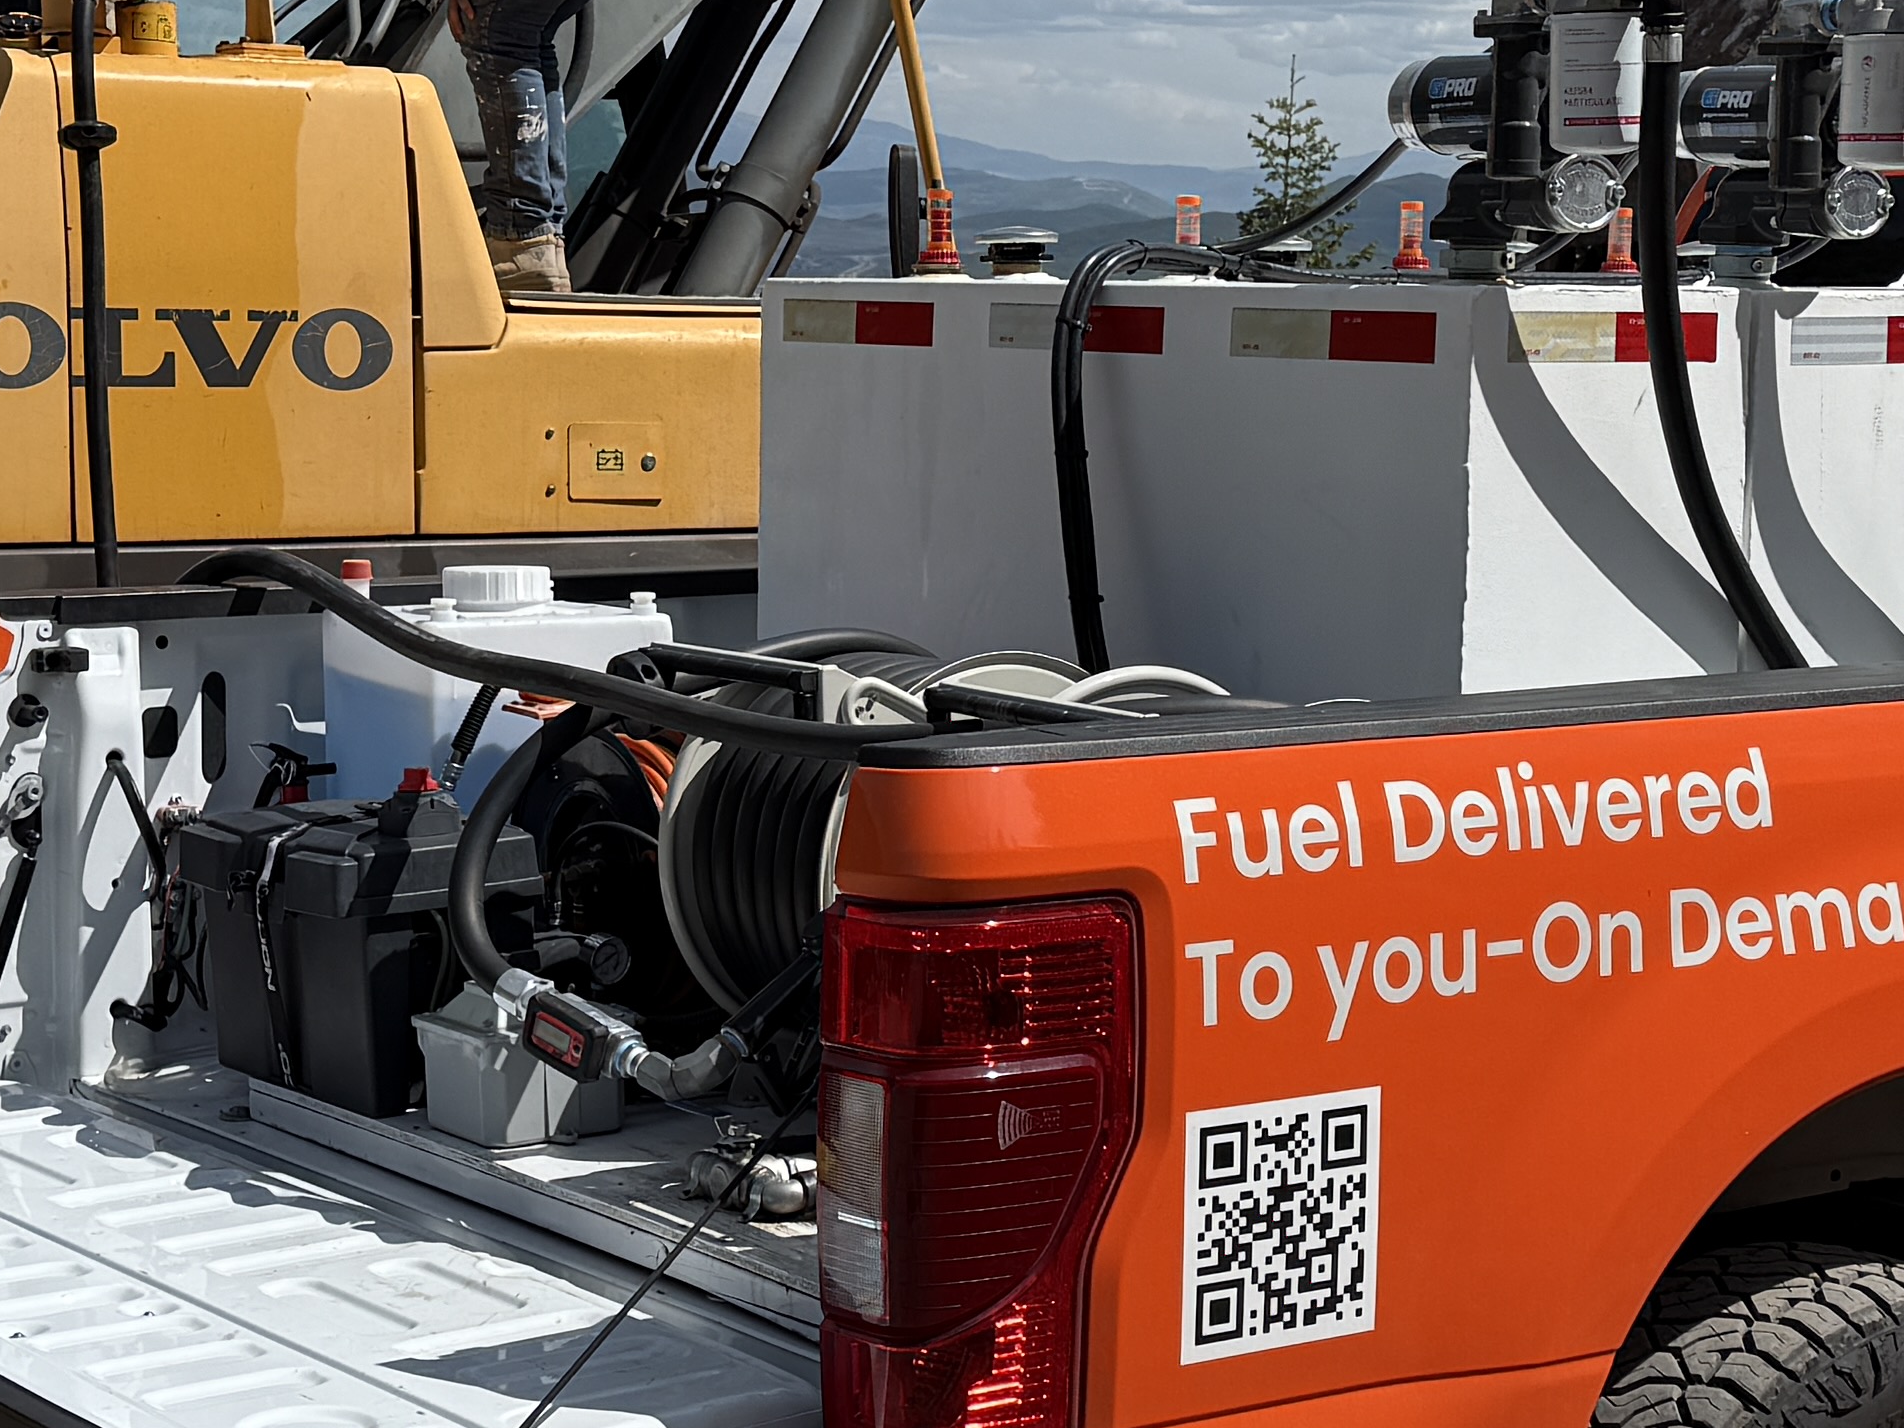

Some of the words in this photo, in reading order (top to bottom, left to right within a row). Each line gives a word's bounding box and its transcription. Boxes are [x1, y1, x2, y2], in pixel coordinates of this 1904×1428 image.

[1172, 779, 1364, 884] Fuel
[1382, 746, 1773, 863] Delivered
[1184, 939, 1293, 1028] To
[1316, 899, 1644, 1042] you-On
